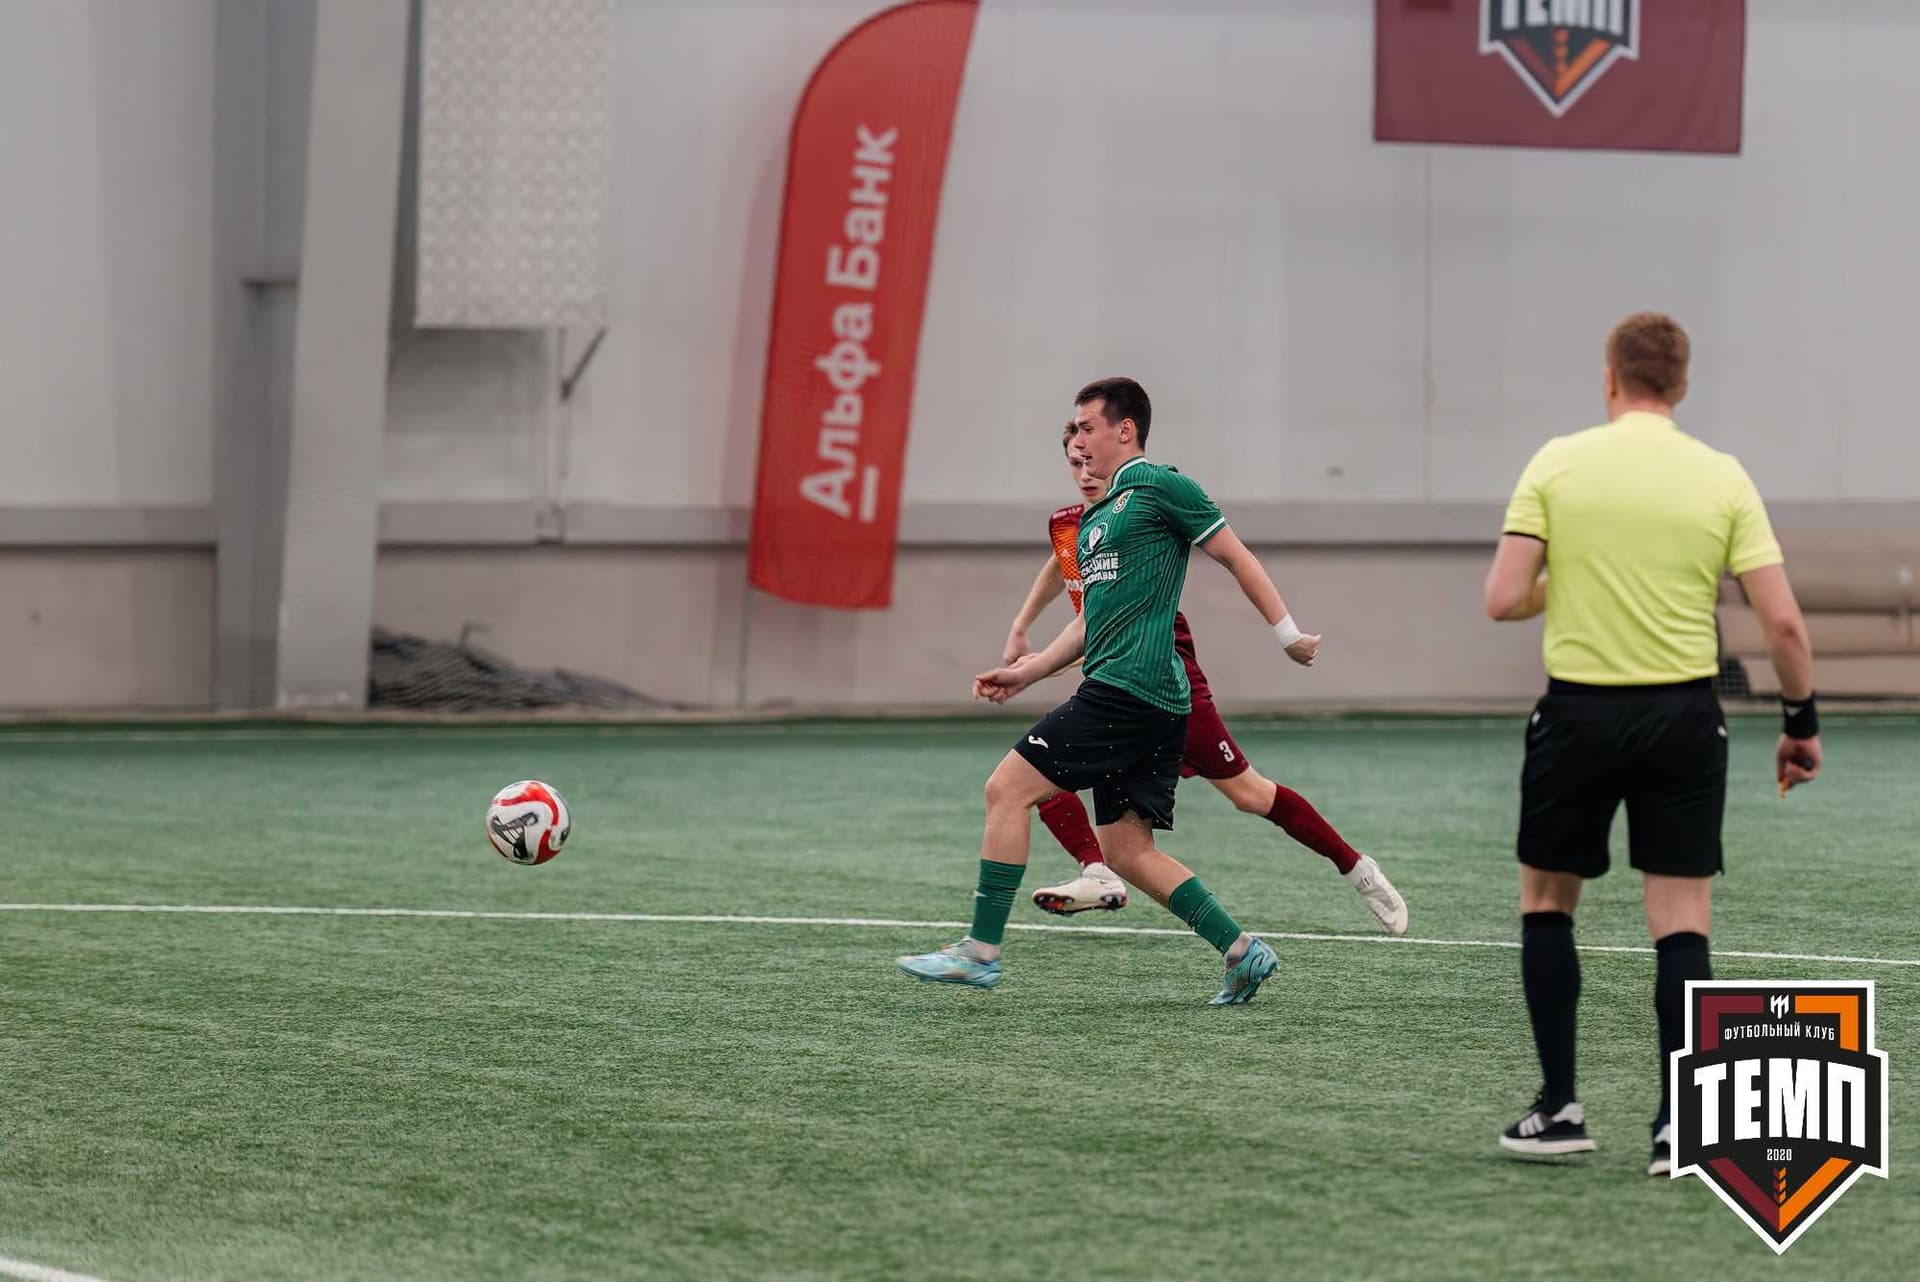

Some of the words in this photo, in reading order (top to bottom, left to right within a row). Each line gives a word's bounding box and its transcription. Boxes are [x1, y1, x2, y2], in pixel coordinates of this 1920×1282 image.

[826, 123, 899, 291] Банк
[801, 303, 881, 519] Альфа
[1218, 740, 1235, 763] 3
